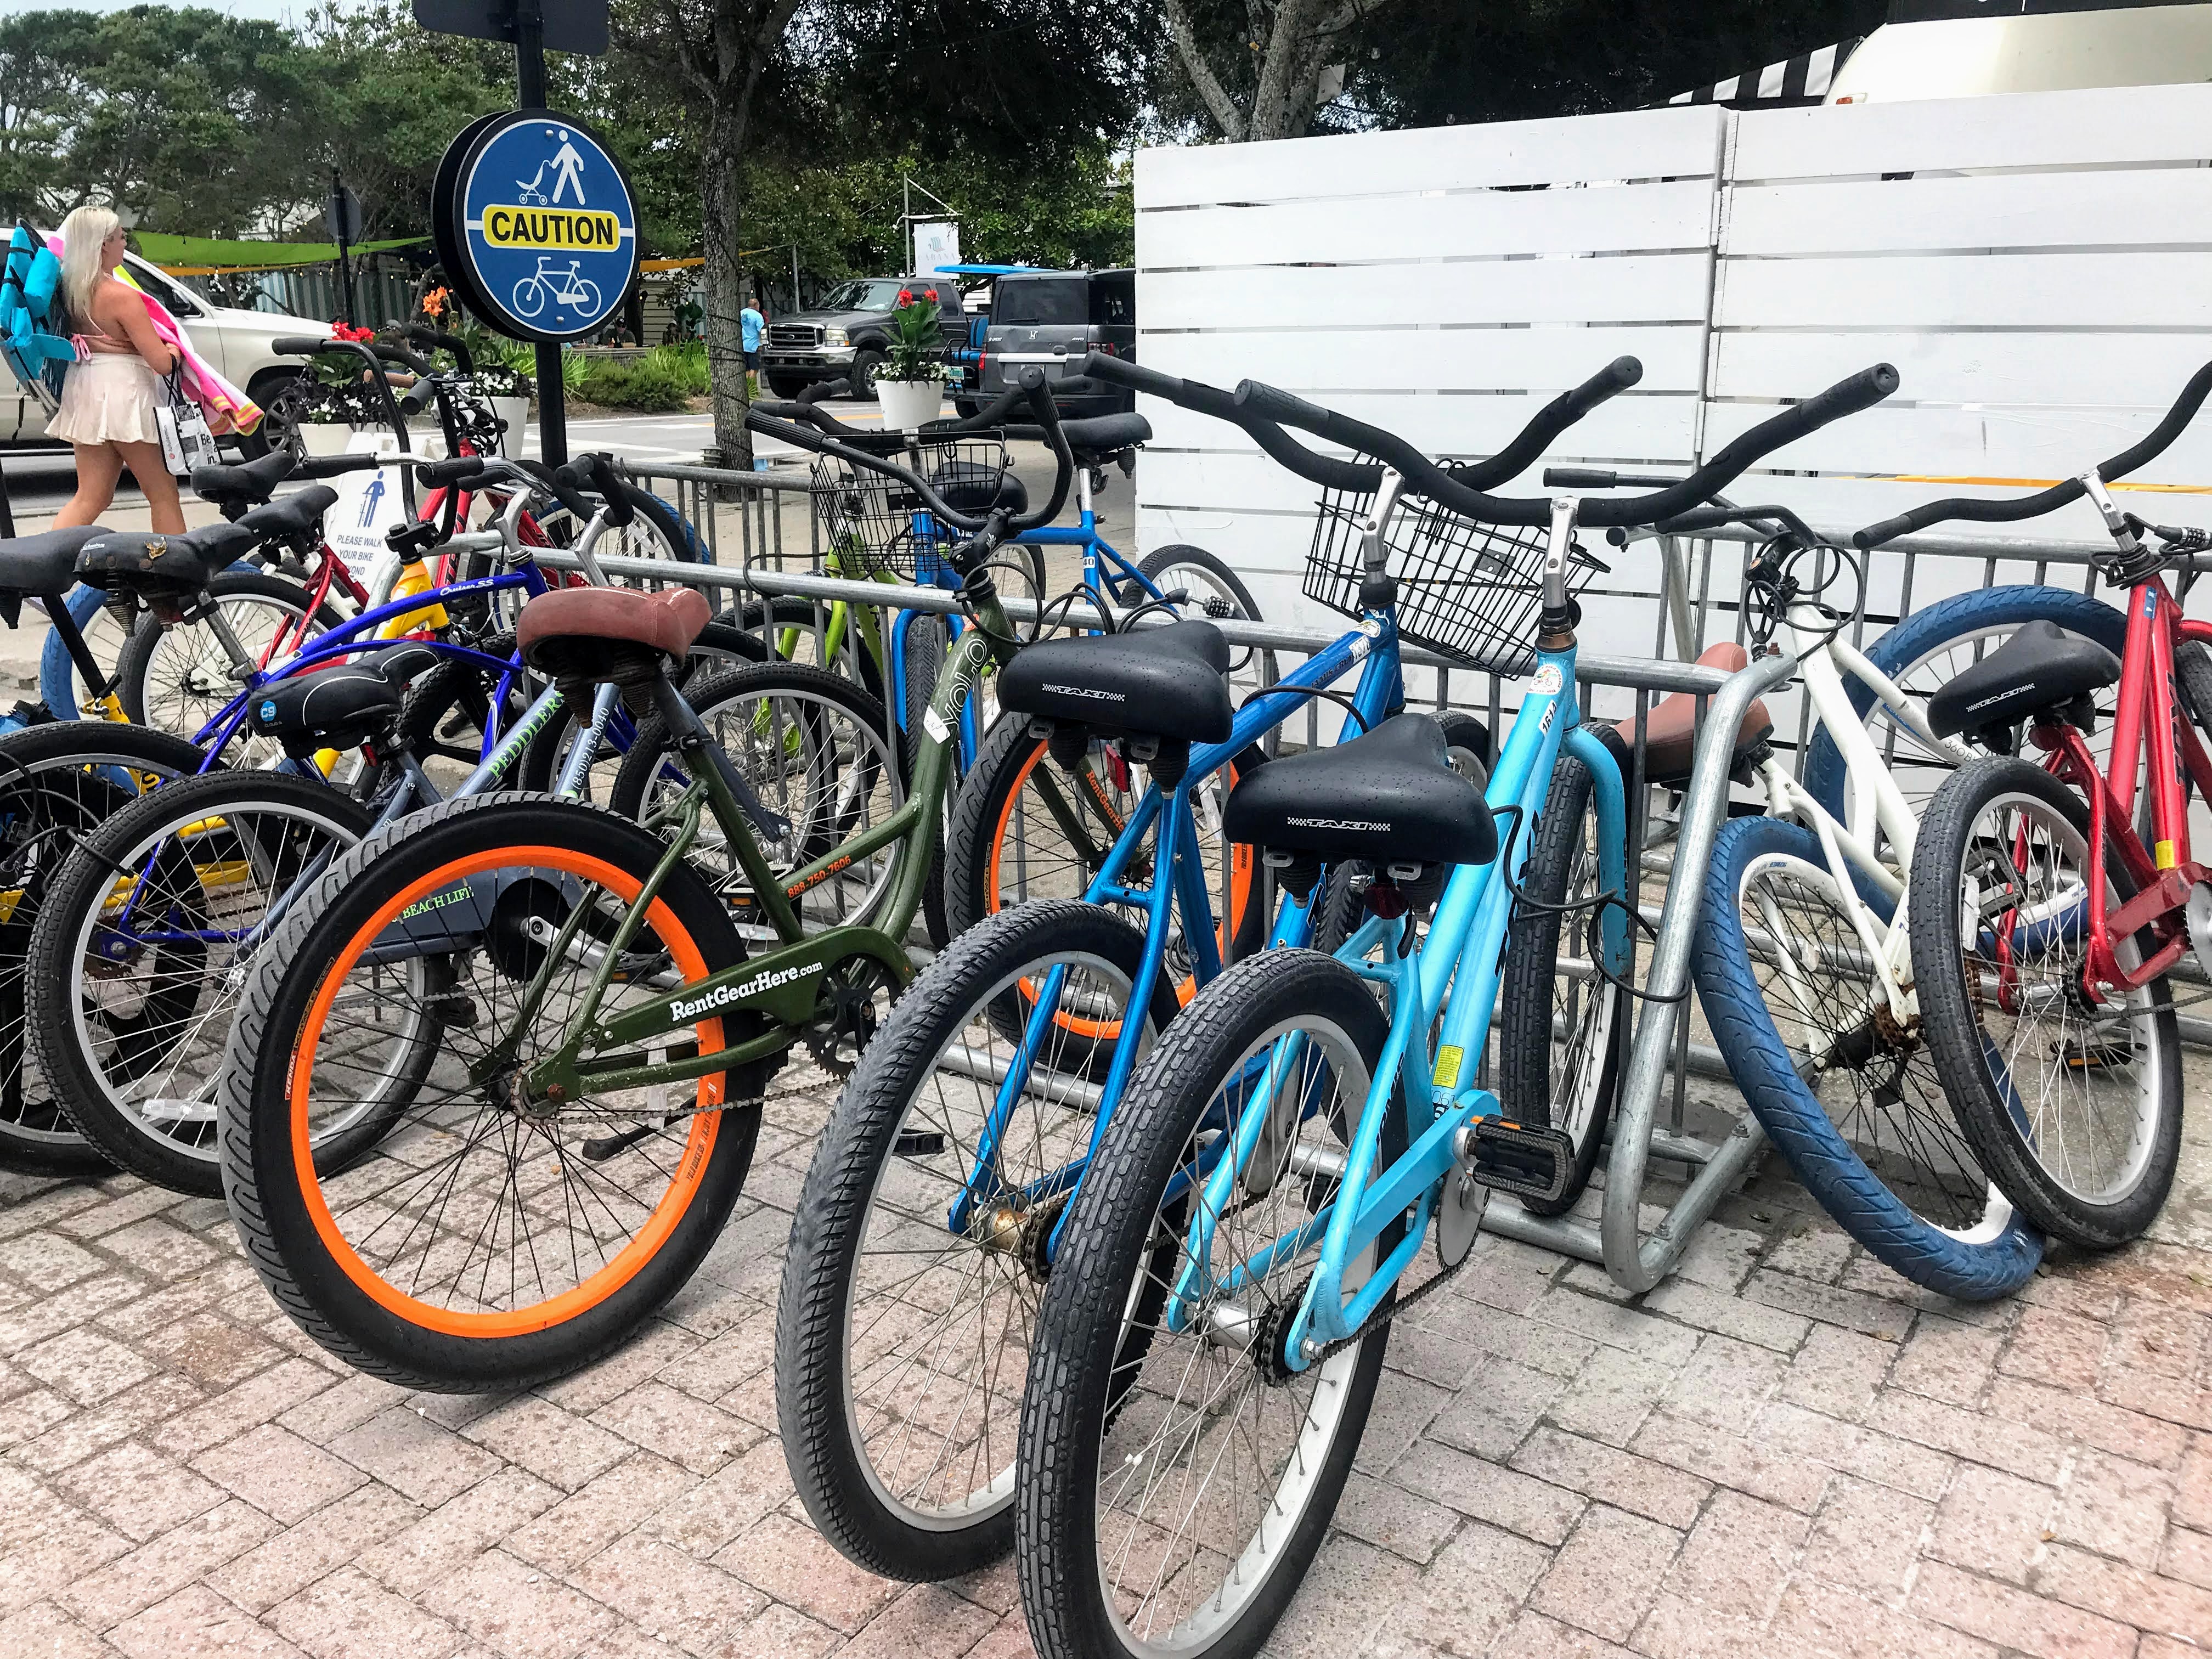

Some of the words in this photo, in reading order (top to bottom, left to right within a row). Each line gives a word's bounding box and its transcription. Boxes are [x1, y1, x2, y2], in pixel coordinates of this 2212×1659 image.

[491, 211, 613, 245] CAUTION
[200, 433, 212, 445] Be
[336, 534, 363, 546] PLEASE
[363, 537, 383, 548] WALK
[339, 549, 358, 560] YOUR
[358, 551, 374, 562] BIKE
[346, 565, 365, 575] YOND
[440, 584, 476, 596] Cruiser
[475, 579, 494, 589] SS
[1334, 653, 1355, 673] CRUI
[941, 638, 988, 727] YOLO
[1057, 685, 1108, 699] TAXI
[1978, 687, 2020, 708] TAXI
[261, 706, 275, 718] C9
[487, 691, 565, 778] PEDDLER
[571, 707, 610, 790] (850)213-0040
[1086, 769, 1125, 832] RentGearHe
[1307, 819, 1369, 831] TAXI
[787, 855, 851, 899] 888-750-7606
[403, 895, 445, 919] BEACH
[445, 886, 475, 905] LIFE
[669, 961, 823, 1022] RentGearHere.com
[285, 1054, 297, 1096] KENDA
